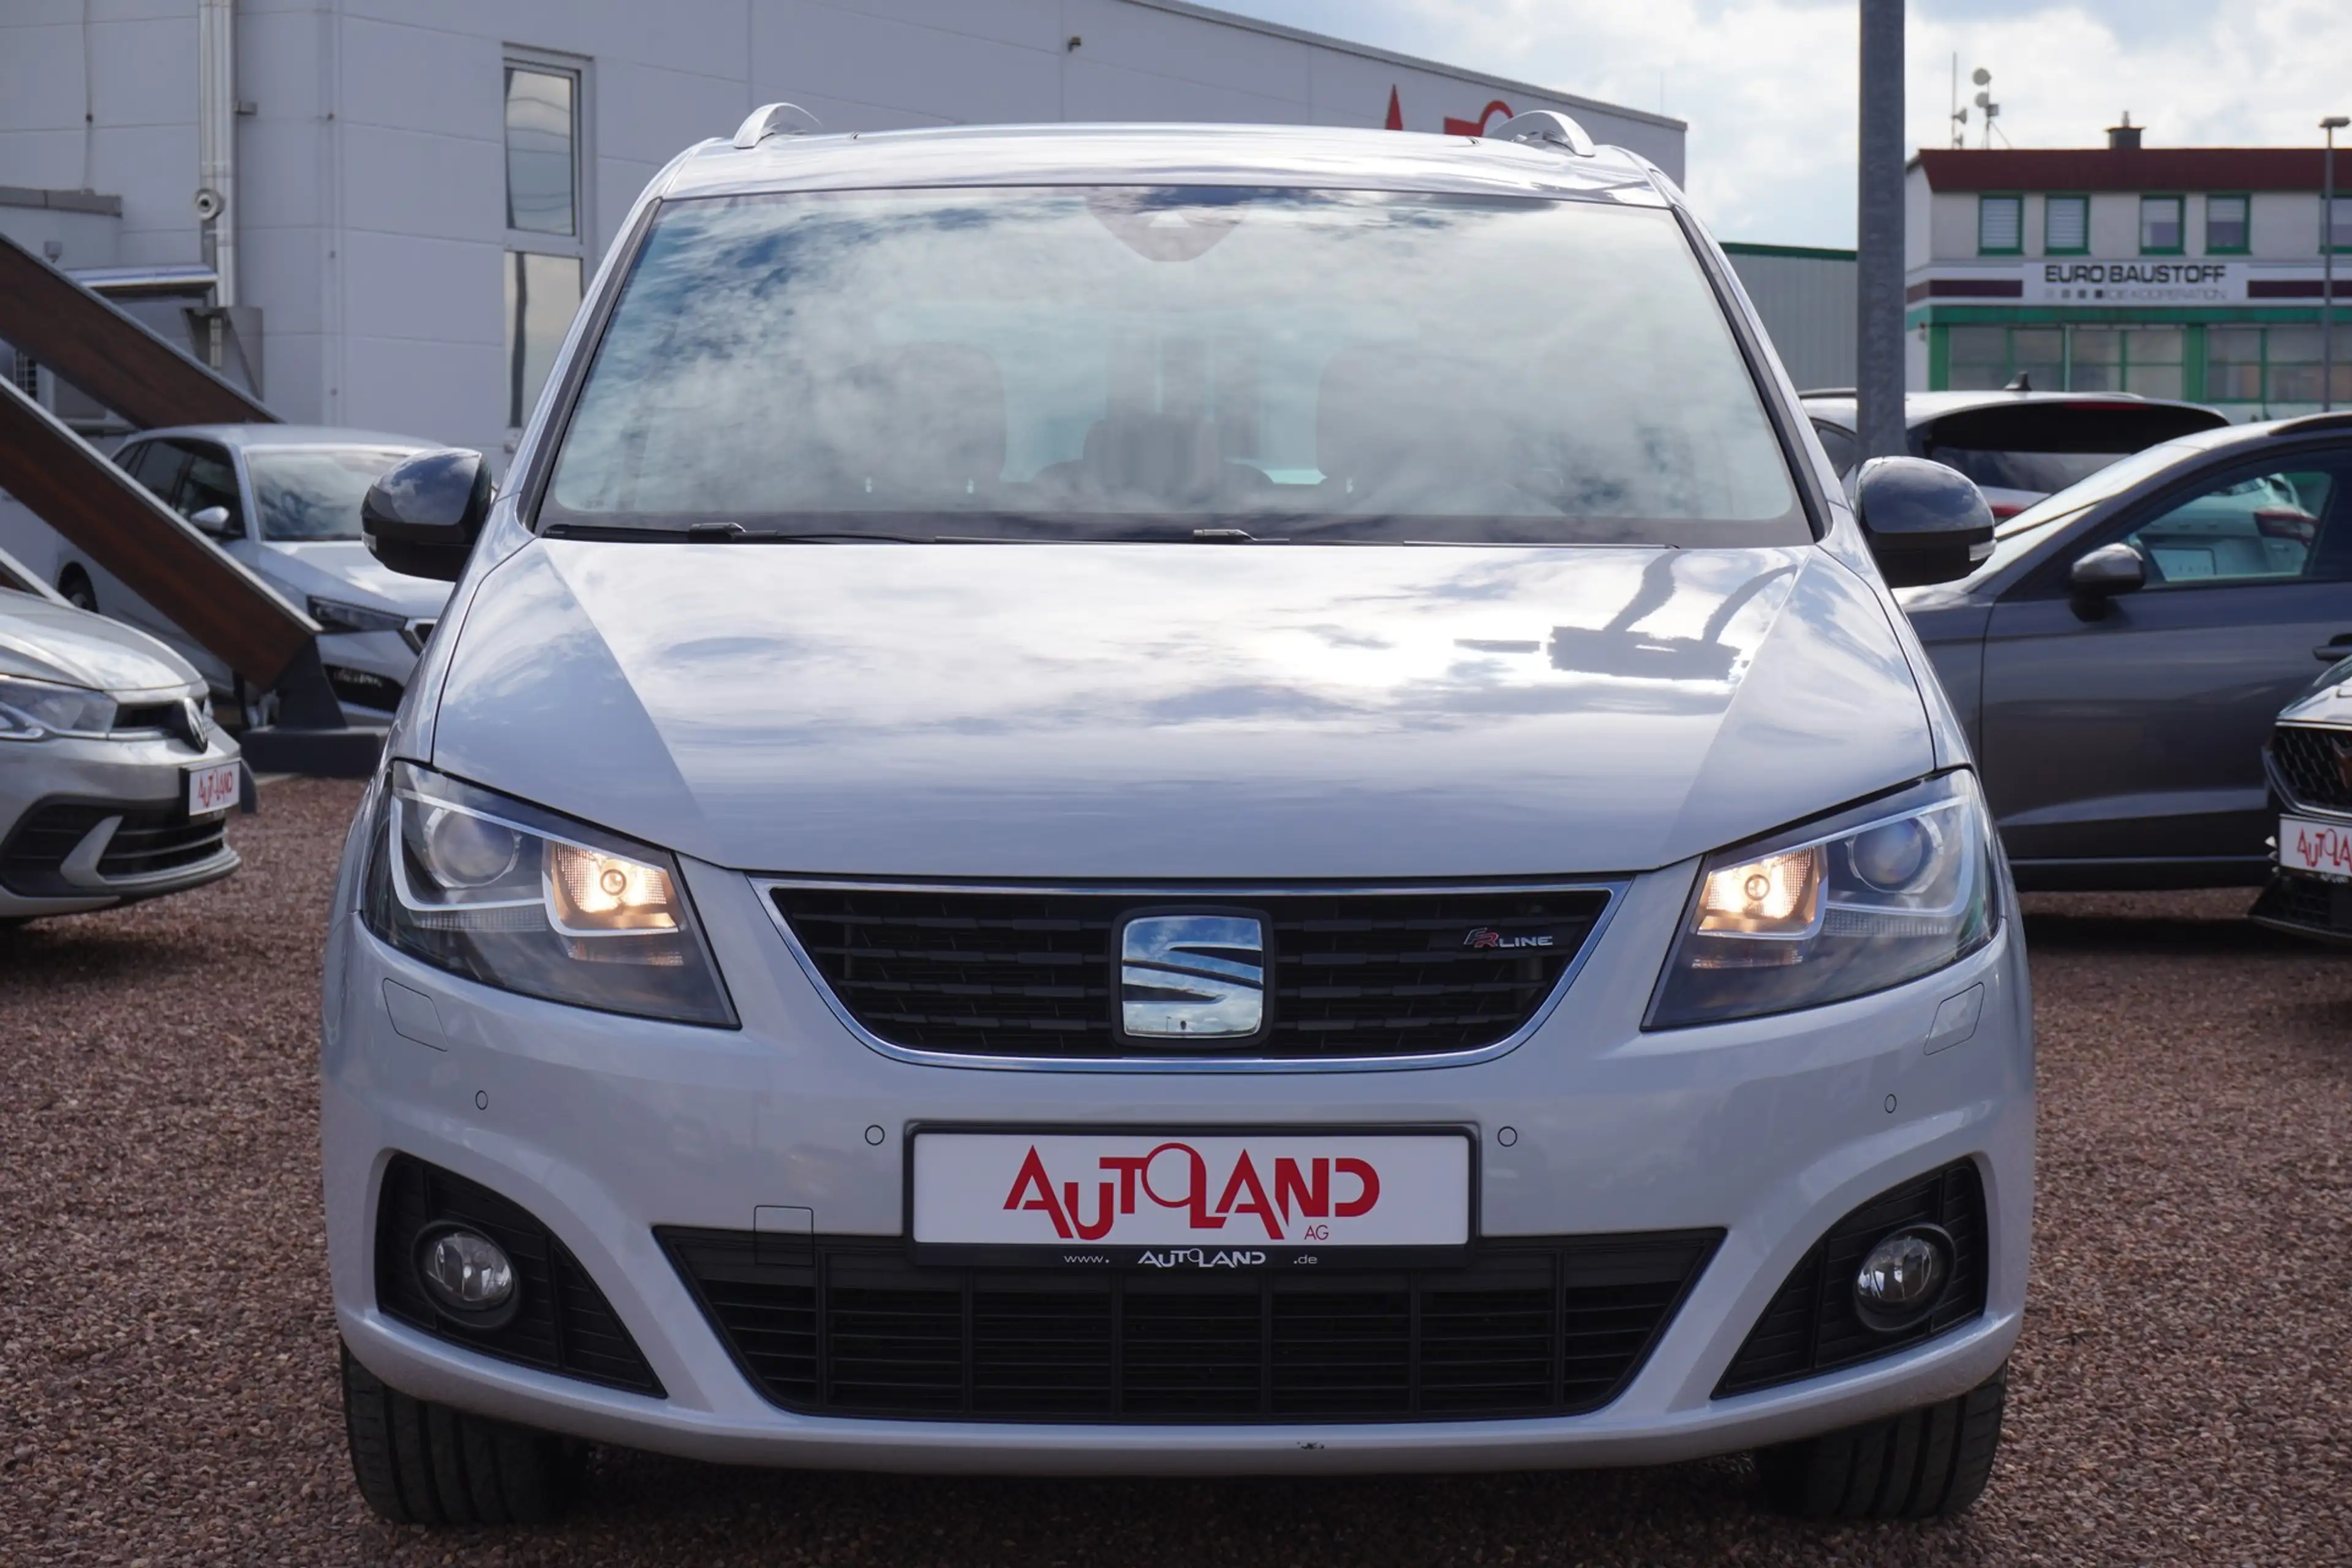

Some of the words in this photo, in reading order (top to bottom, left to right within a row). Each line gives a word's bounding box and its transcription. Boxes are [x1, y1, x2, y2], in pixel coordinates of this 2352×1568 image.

[1003, 1143, 1380, 1240] AUTOLAND
[1304, 1226, 1329, 1240] AG
[1137, 1248, 1266, 1268] AUTOLAND
